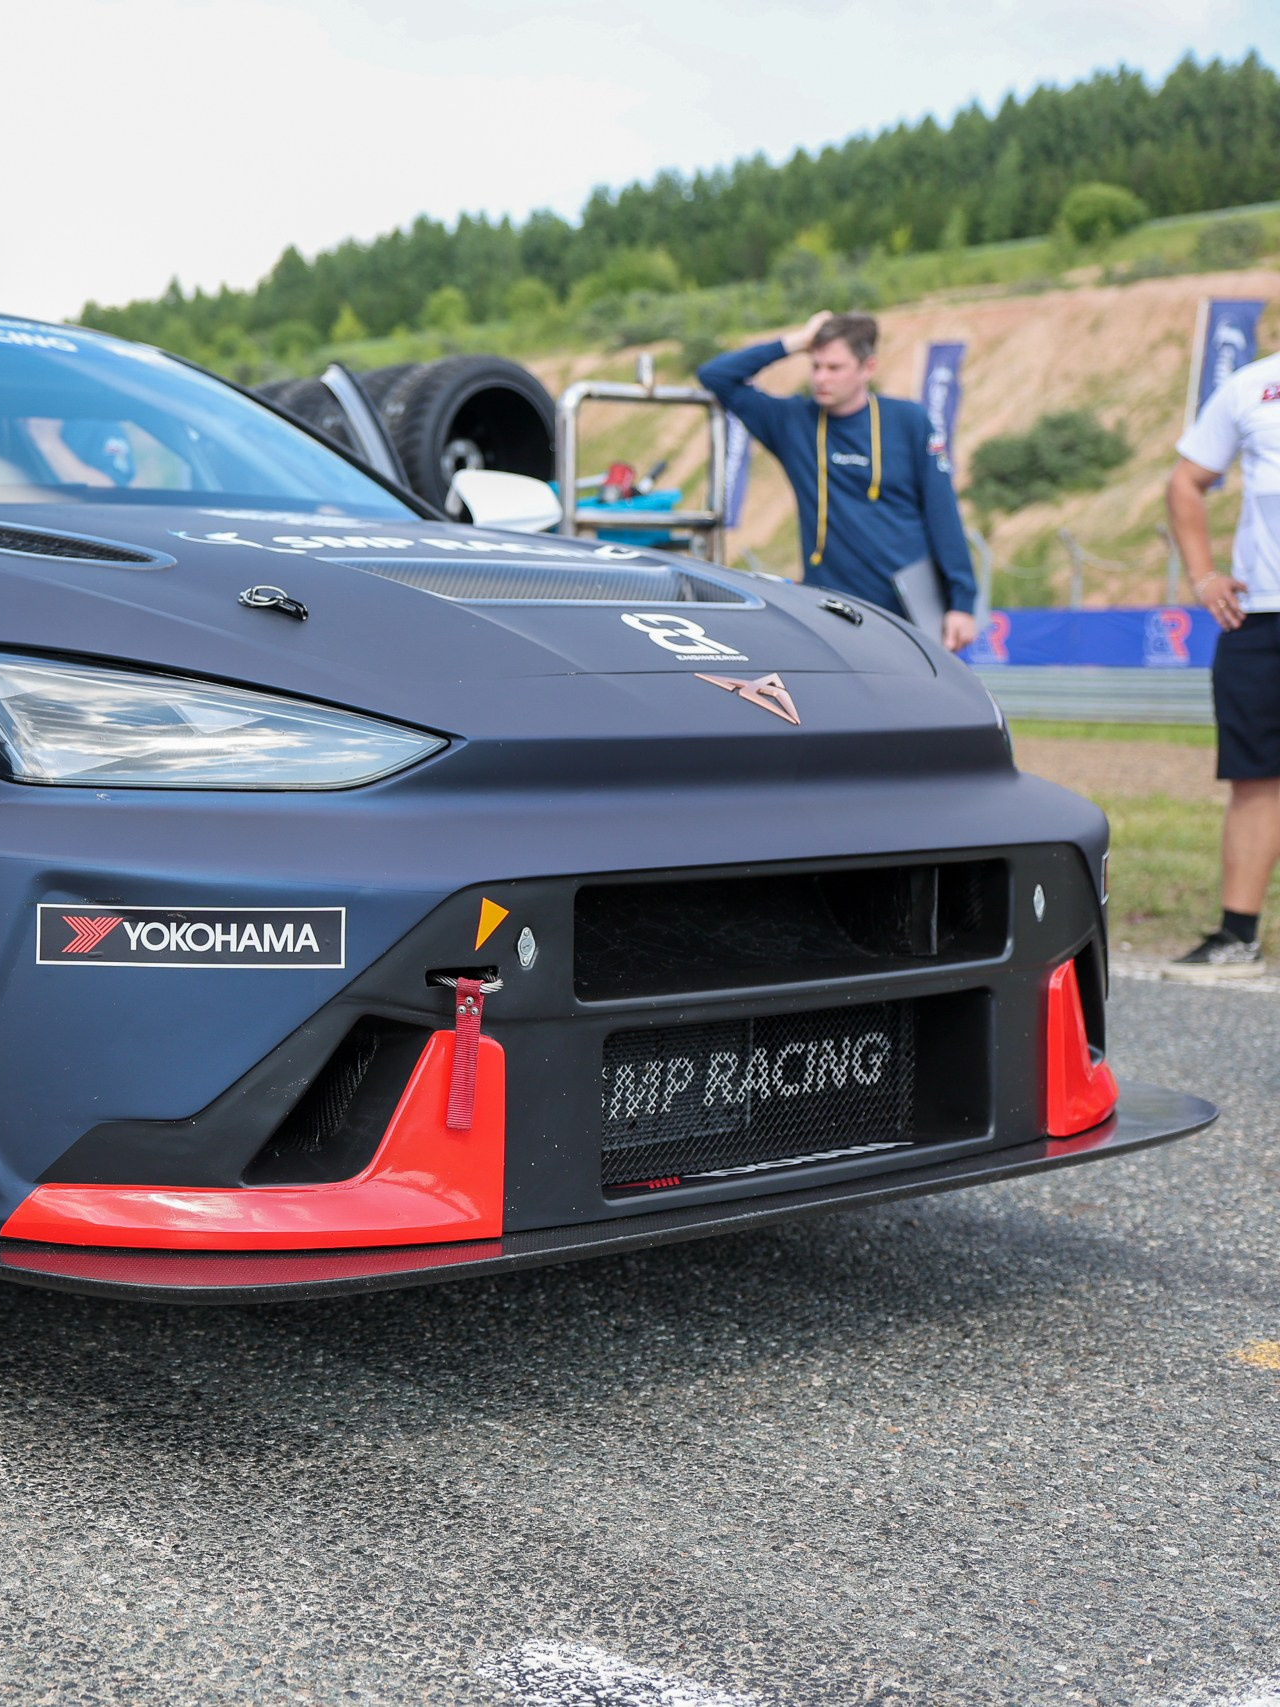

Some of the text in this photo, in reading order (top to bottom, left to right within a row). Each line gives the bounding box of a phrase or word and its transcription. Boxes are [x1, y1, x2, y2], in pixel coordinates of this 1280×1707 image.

[271, 535, 417, 550] SMP
[122, 921, 321, 953] YOKOHAMA
[703, 1032, 891, 1108] RACING
